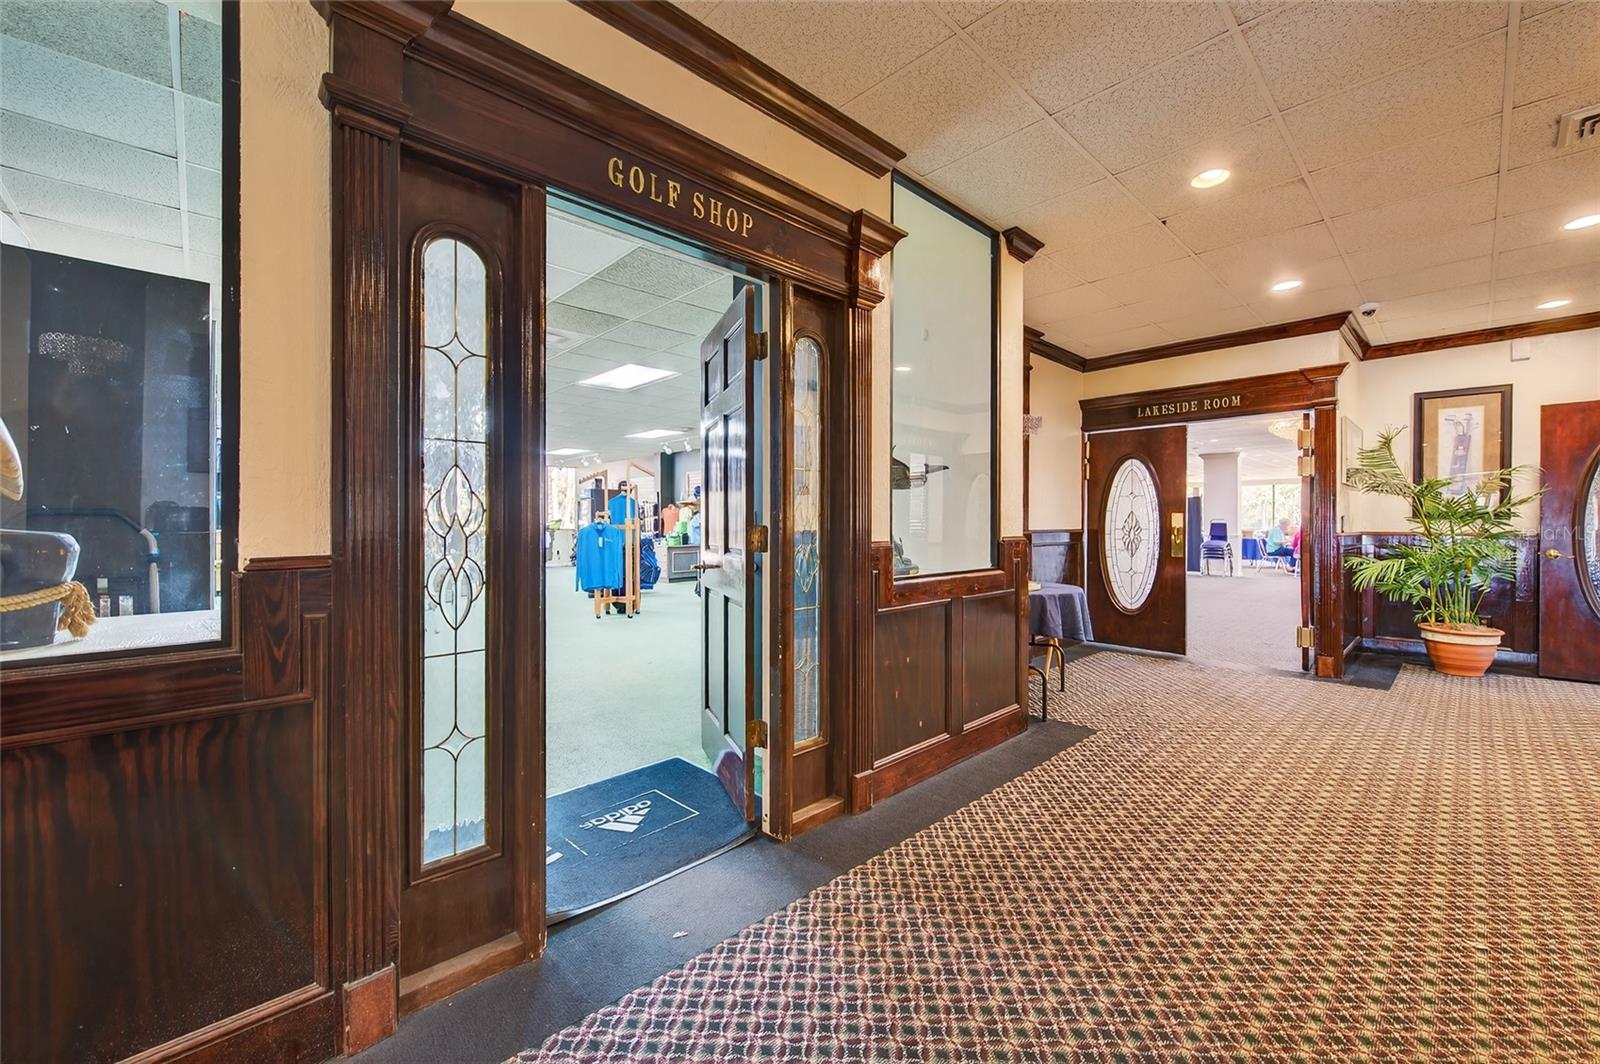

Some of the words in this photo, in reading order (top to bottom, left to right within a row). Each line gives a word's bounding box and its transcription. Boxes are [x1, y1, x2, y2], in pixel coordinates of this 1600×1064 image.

[608, 157, 681, 209] GOLF
[692, 191, 753, 238] SHOP
[1137, 400, 1198, 418] LAKESIDE
[1204, 395, 1241, 410] ROOM
[579, 800, 652, 830] adidas
